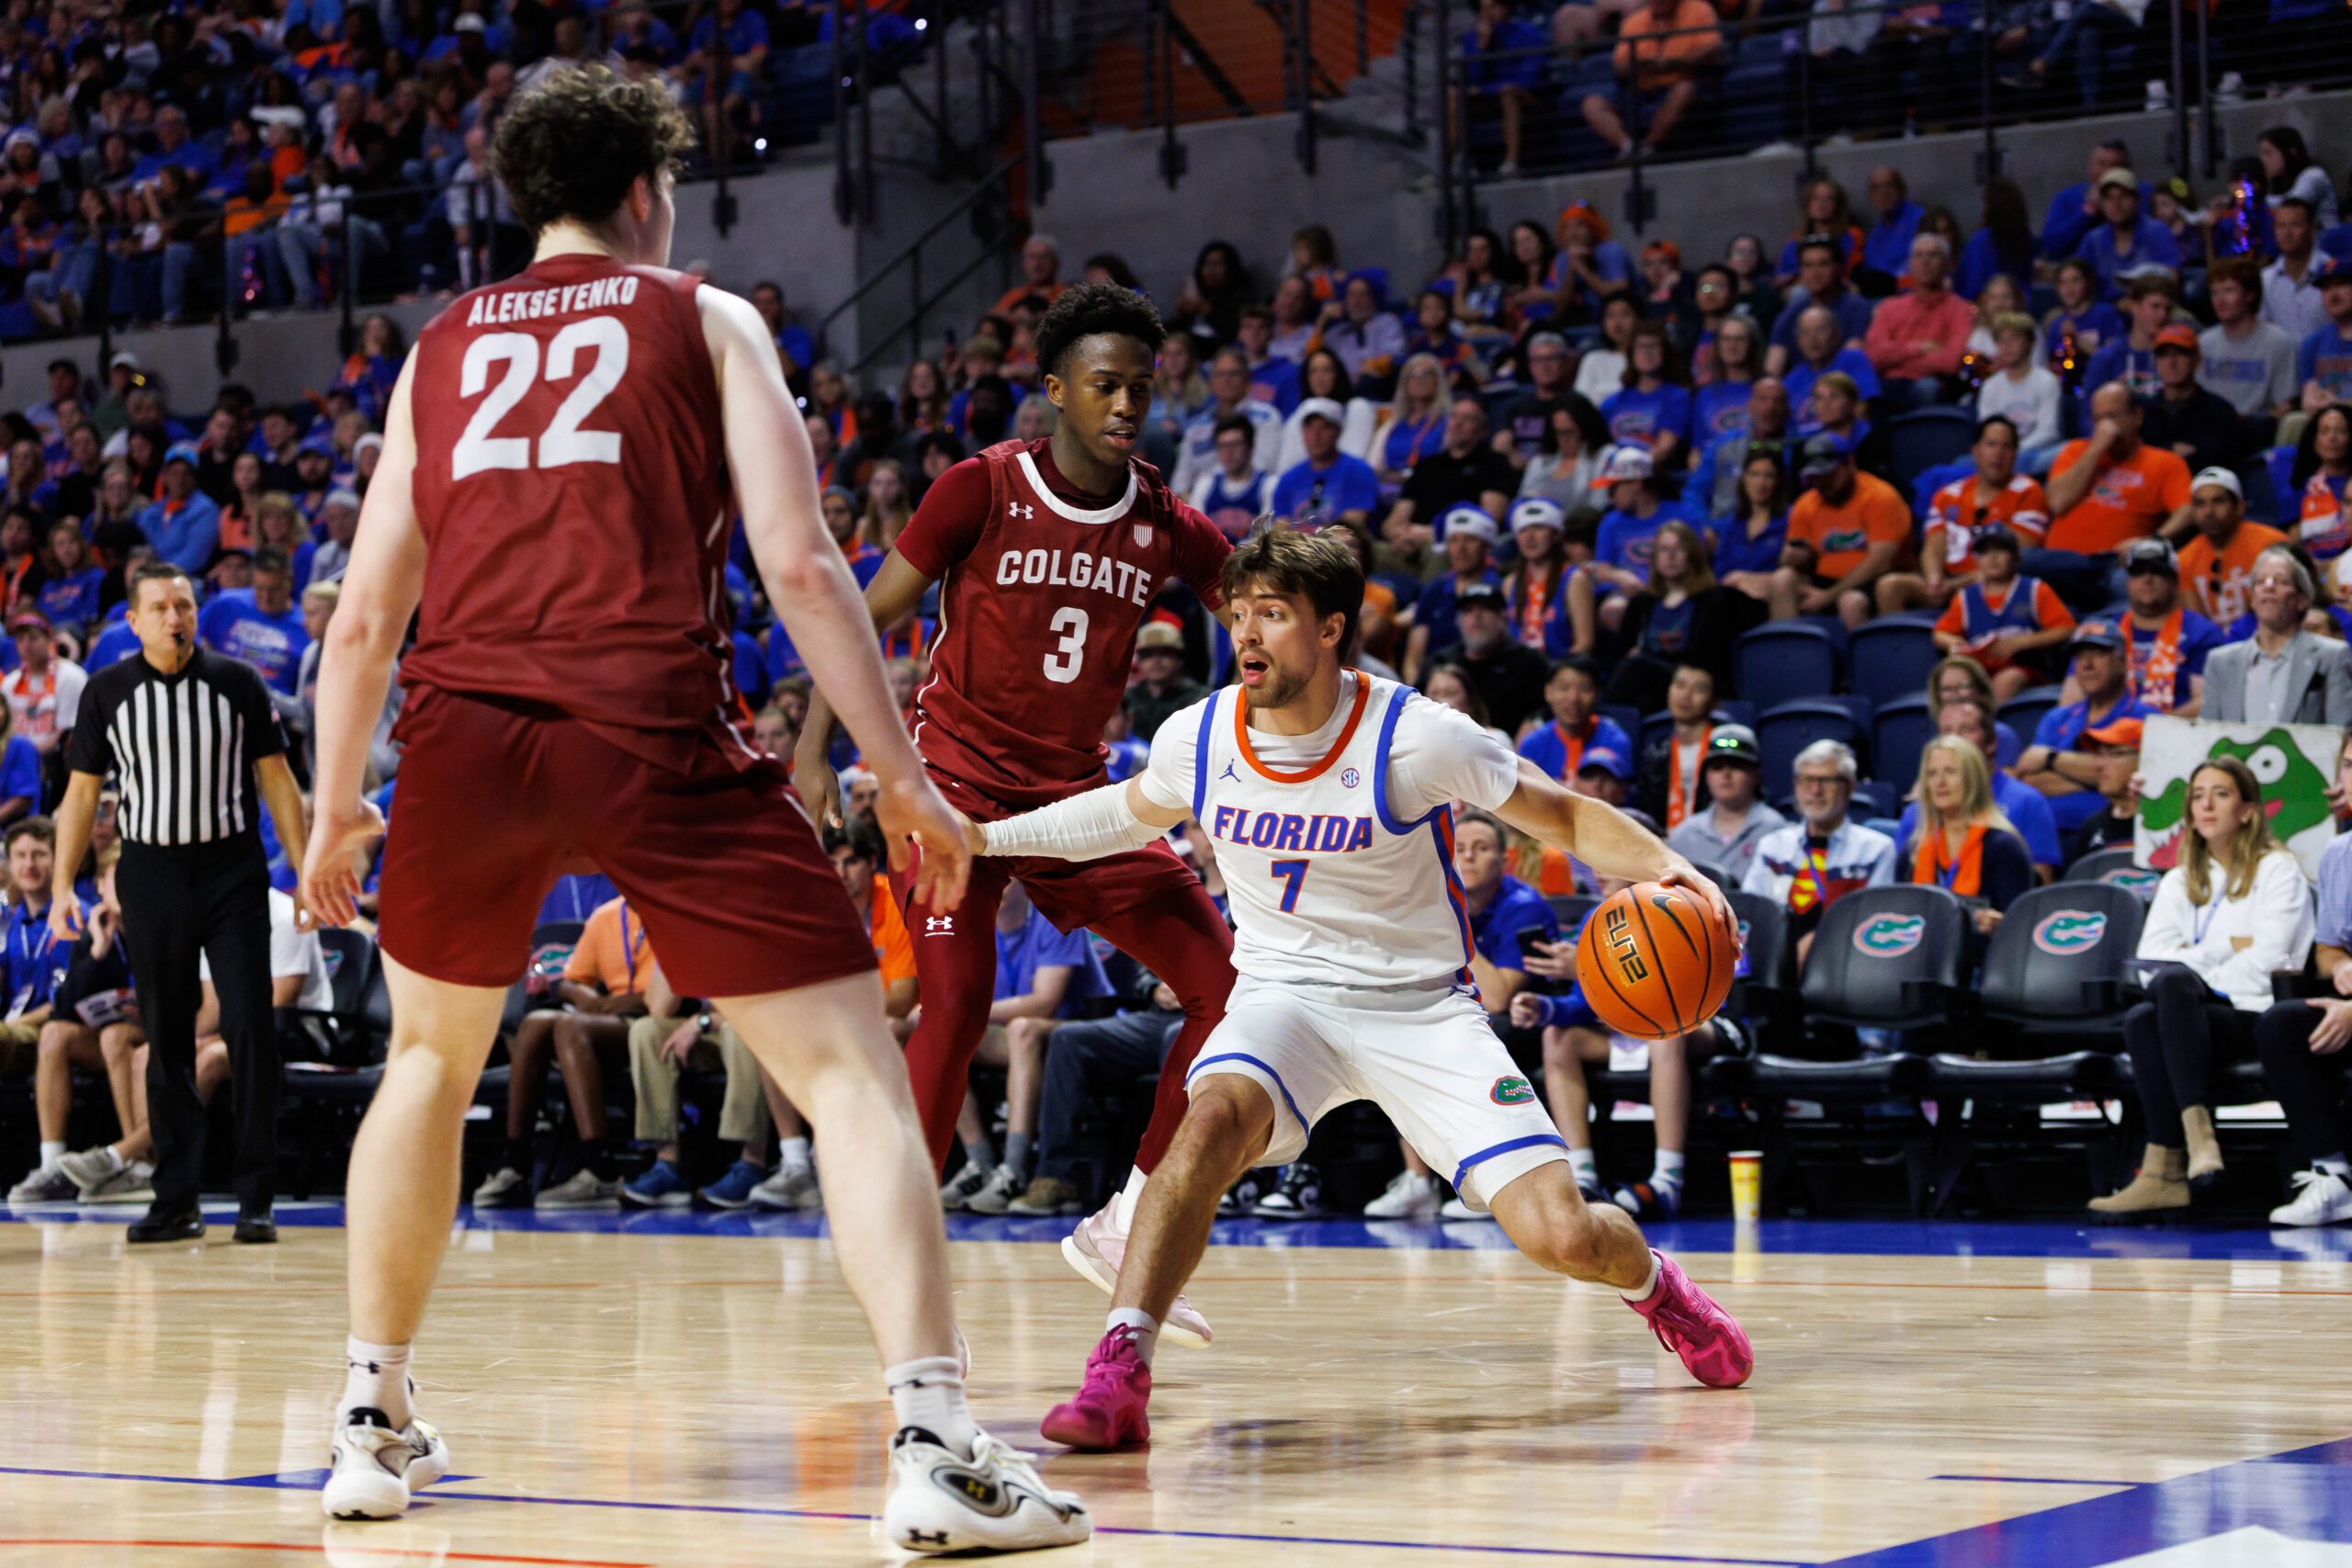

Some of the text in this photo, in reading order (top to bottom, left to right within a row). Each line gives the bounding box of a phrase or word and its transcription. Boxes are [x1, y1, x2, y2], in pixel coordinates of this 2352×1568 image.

[467, 276, 639, 327] ALEKSEYENKO
[452, 315, 629, 481] 22
[996, 548, 1151, 608] COLGATE
[1043, 606, 1089, 684] 3
[1341, 769, 1360, 787] SEC
[1213, 805, 1373, 852] FLORIDA
[1271, 858, 1311, 915] 7
[1605, 905, 1649, 984] ELITE
